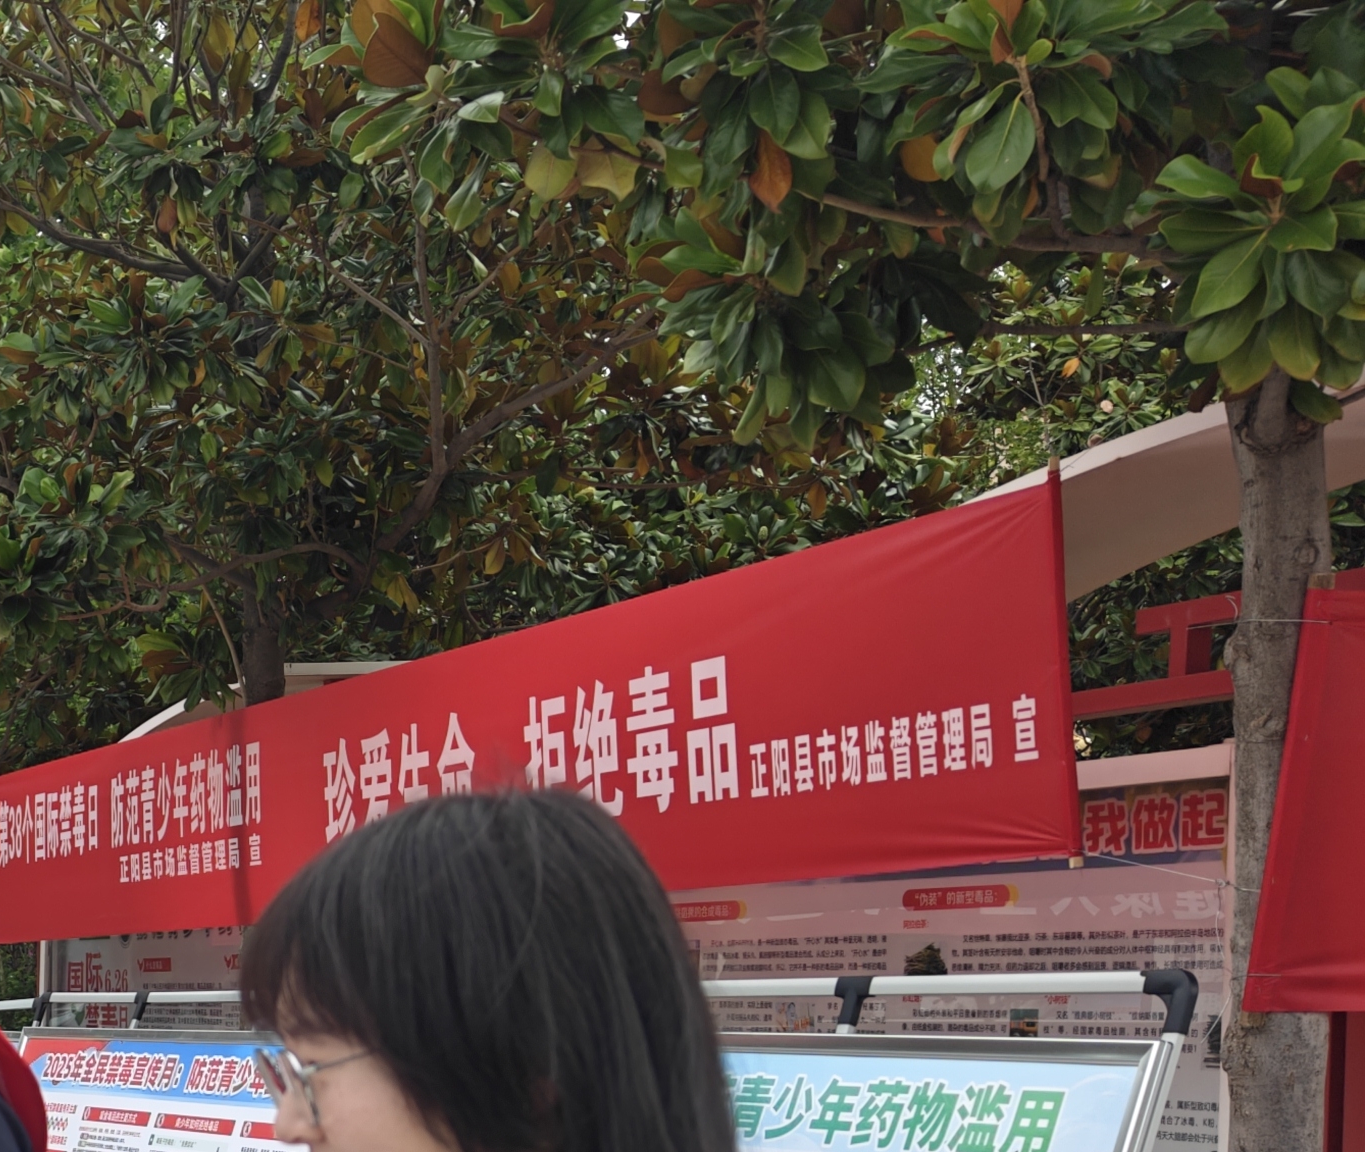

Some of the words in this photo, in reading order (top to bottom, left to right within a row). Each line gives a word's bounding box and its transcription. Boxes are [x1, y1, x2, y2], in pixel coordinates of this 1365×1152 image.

[110, 741, 262, 848] 防范青少年药物滥用
[749, 702, 993, 799] 正阳县市场监督管理局
[1012, 693, 1039, 762] 宣
[119, 835, 240, 884] 正阳县市场监督管理局
[248, 833, 263, 867] 宣
